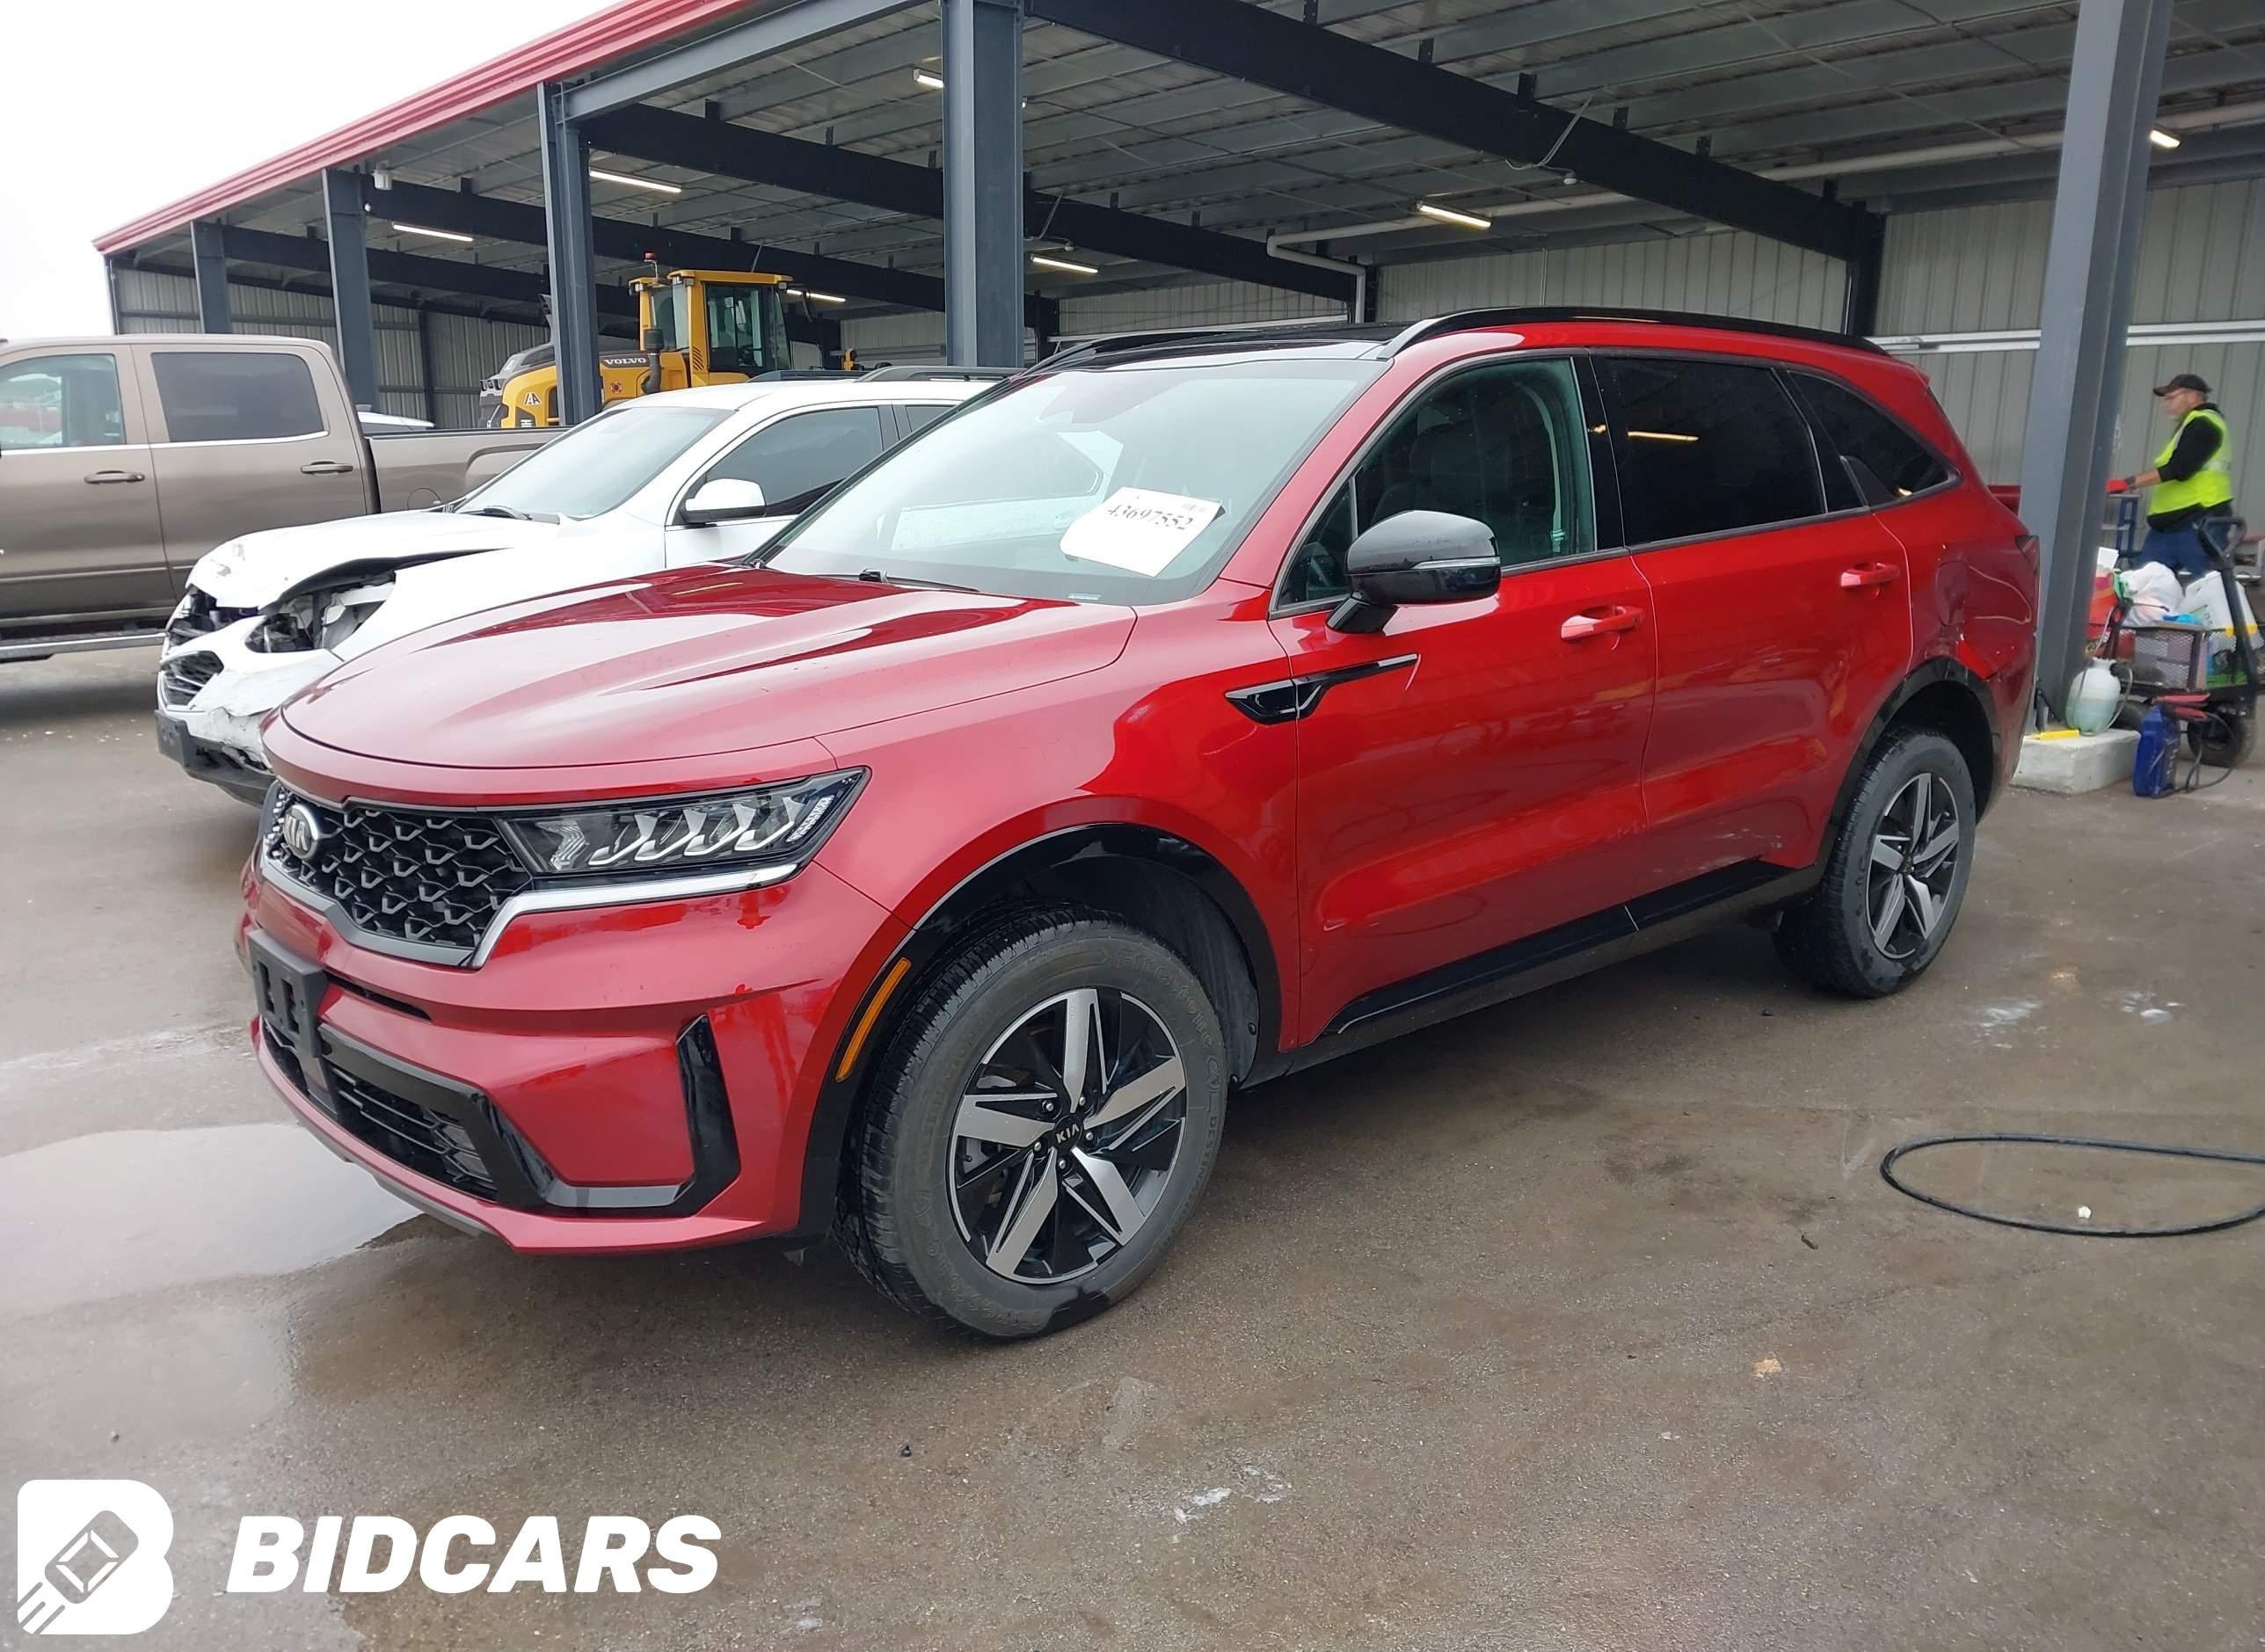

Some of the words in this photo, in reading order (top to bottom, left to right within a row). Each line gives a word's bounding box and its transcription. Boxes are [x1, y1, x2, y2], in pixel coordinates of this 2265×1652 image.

[1107, 504, 1194, 529] 43697552
[286, 814, 308, 851] KIA
[1055, 1124, 1080, 1144] KIA
